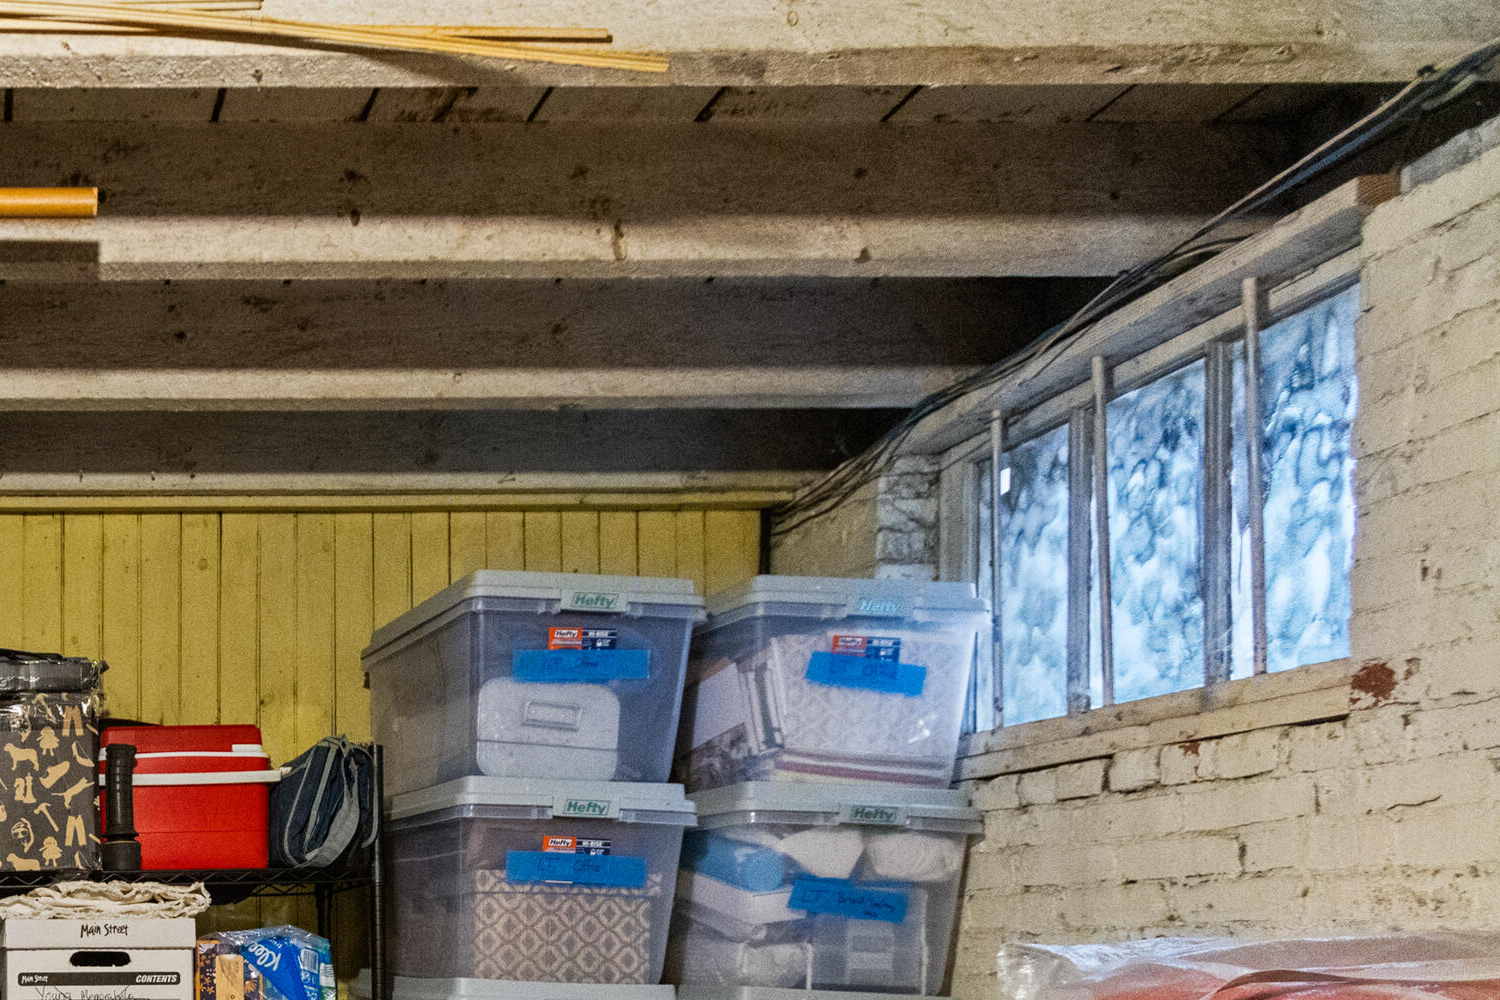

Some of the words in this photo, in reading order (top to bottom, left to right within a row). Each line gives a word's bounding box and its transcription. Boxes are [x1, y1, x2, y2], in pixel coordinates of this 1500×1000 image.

[574, 595, 615, 608] Hefty
[859, 600, 899, 612] Hefty
[555, 630, 578, 638] Hefty
[567, 803, 606, 816] Hefty
[853, 807, 895, 819] Hefty
[549, 838, 573, 847] Hefty
[80, 923, 101, 938] Main
[104, 923, 129, 936] Street
[21, 975, 34, 984] Main
[34, 975, 49, 983] Street
[135, 974, 178, 983] CONTENTS
